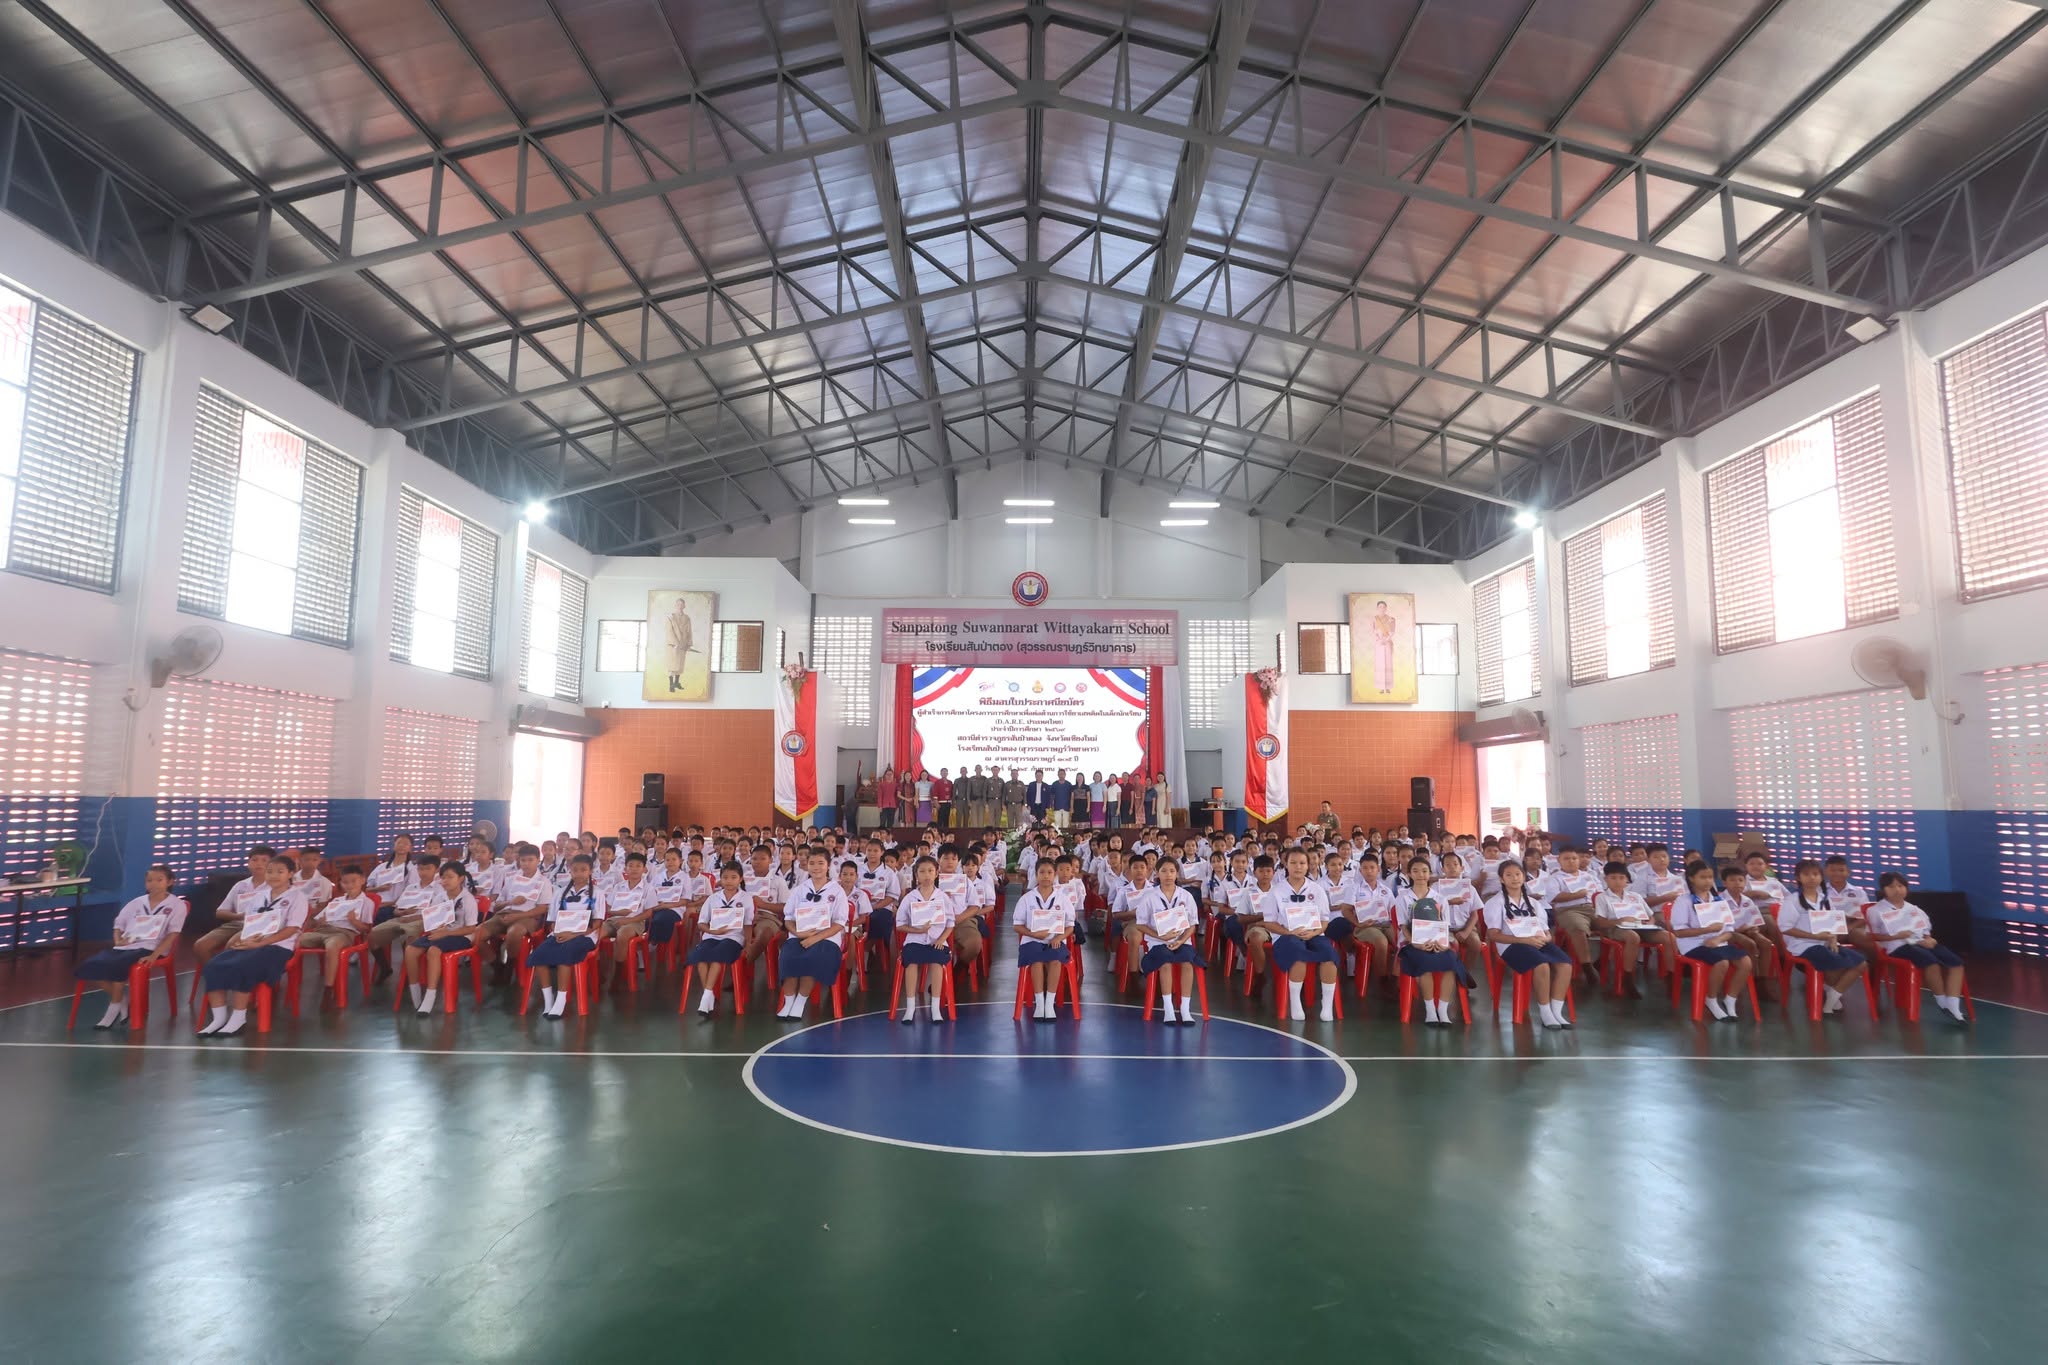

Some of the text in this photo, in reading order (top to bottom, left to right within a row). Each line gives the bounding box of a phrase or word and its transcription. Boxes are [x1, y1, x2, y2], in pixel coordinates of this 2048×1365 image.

[891, 620, 1170, 637] Sanpatong Suwannarat Wittayakarn School
[925, 639, 1013, 652] โรงเรียนสันป่าตอง
